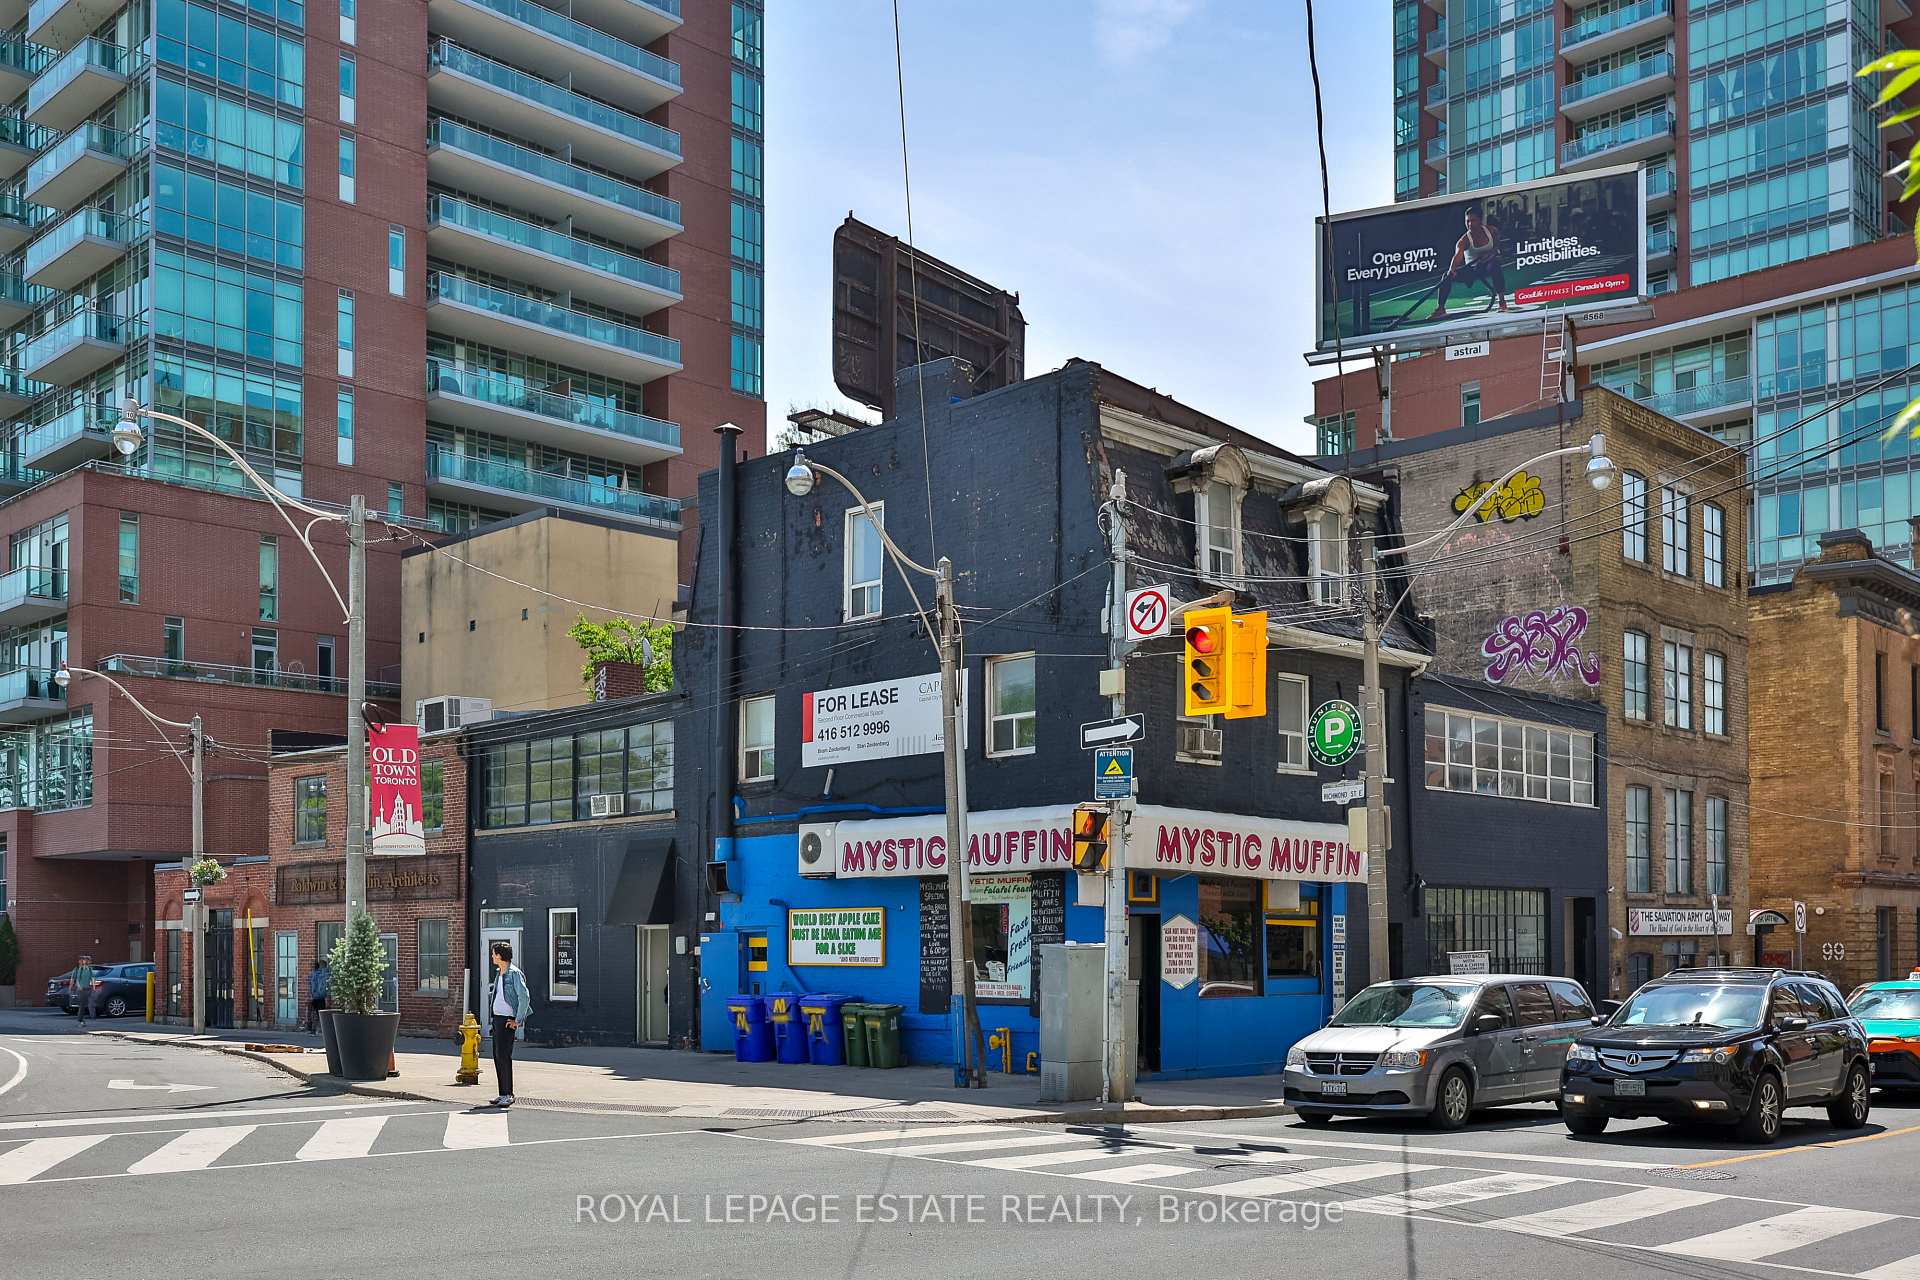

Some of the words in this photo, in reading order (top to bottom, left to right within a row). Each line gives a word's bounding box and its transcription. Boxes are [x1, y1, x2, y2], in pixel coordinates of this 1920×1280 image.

[1516, 236, 1578, 255] Limitless
[1373, 251, 1401, 265] One
[1403, 247, 1437, 263] gym.
[1516, 245, 1601, 270] possibilities.
[1347, 266, 1383, 280] Every
[1385, 259, 1437, 278] journey.
[1518, 290, 1543, 300] GoodLife
[1544, 287, 1570, 296] FITNESS
[1575, 281, 1604, 292] Canada's
[1583, 312, 1604, 321] 8568
[1453, 345, 1482, 357] astral
[818, 695, 847, 714] FOR
[851, 687, 899, 709] LEASE
[1309, 703, 1360, 734] MUNICIPAL
[818, 727, 837, 741] 416
[840, 724, 860, 738] 512
[863, 720, 890, 736] 9996
[1325, 717, 1346, 743] P
[373, 747, 417, 764] OLD
[1310, 736, 1359, 763] PARKING
[373, 764, 416, 776] TOWN
[374, 777, 417, 785] TORONTO
[1324, 792, 1348, 801] RICHMOND
[842, 835, 946, 872] MYSTIC
[968, 828, 1072, 866] MUFFIN
[1156, 825, 1262, 871] MYSTIC
[1269, 836, 1361, 877] MUFFIN
[291, 877, 327, 893] Baldwin
[329, 877, 337, 890] &
[386, 871, 440, 888] Architects
[997, 876, 1032, 884] MUFFIN
[984, 885, 1011, 894] Falafel
[1032, 889, 1060, 898] MUFFIN
[501, 915, 514, 924] 157
[793, 913, 817, 926] WORLD
[819, 913, 836, 925] BEST
[838, 912, 860, 925] APPLE
[862, 912, 880, 924] CAKE
[1641, 912, 1653, 921] THE
[1654, 911, 1685, 921] SALVATION
[1688, 912, 1703, 921] ARMY
[1705, 911, 1730, 921] GAWAY
[792, 928, 809, 940] MUST
[811, 928, 820, 940] BE
[821, 928, 840, 940] LEGAL
[842, 928, 866, 940] EATING
[868, 927, 882, 940] AGE
[1010, 916, 1029, 938] Fast
[1658, 924, 1668, 932] Hand
[815, 943, 829, 954] FOR
[831, 943, 836, 954] A
[838, 943, 856, 955] SLICE
[1822, 942, 1845, 960] 99
[1007, 955, 1032, 975] Friendl
